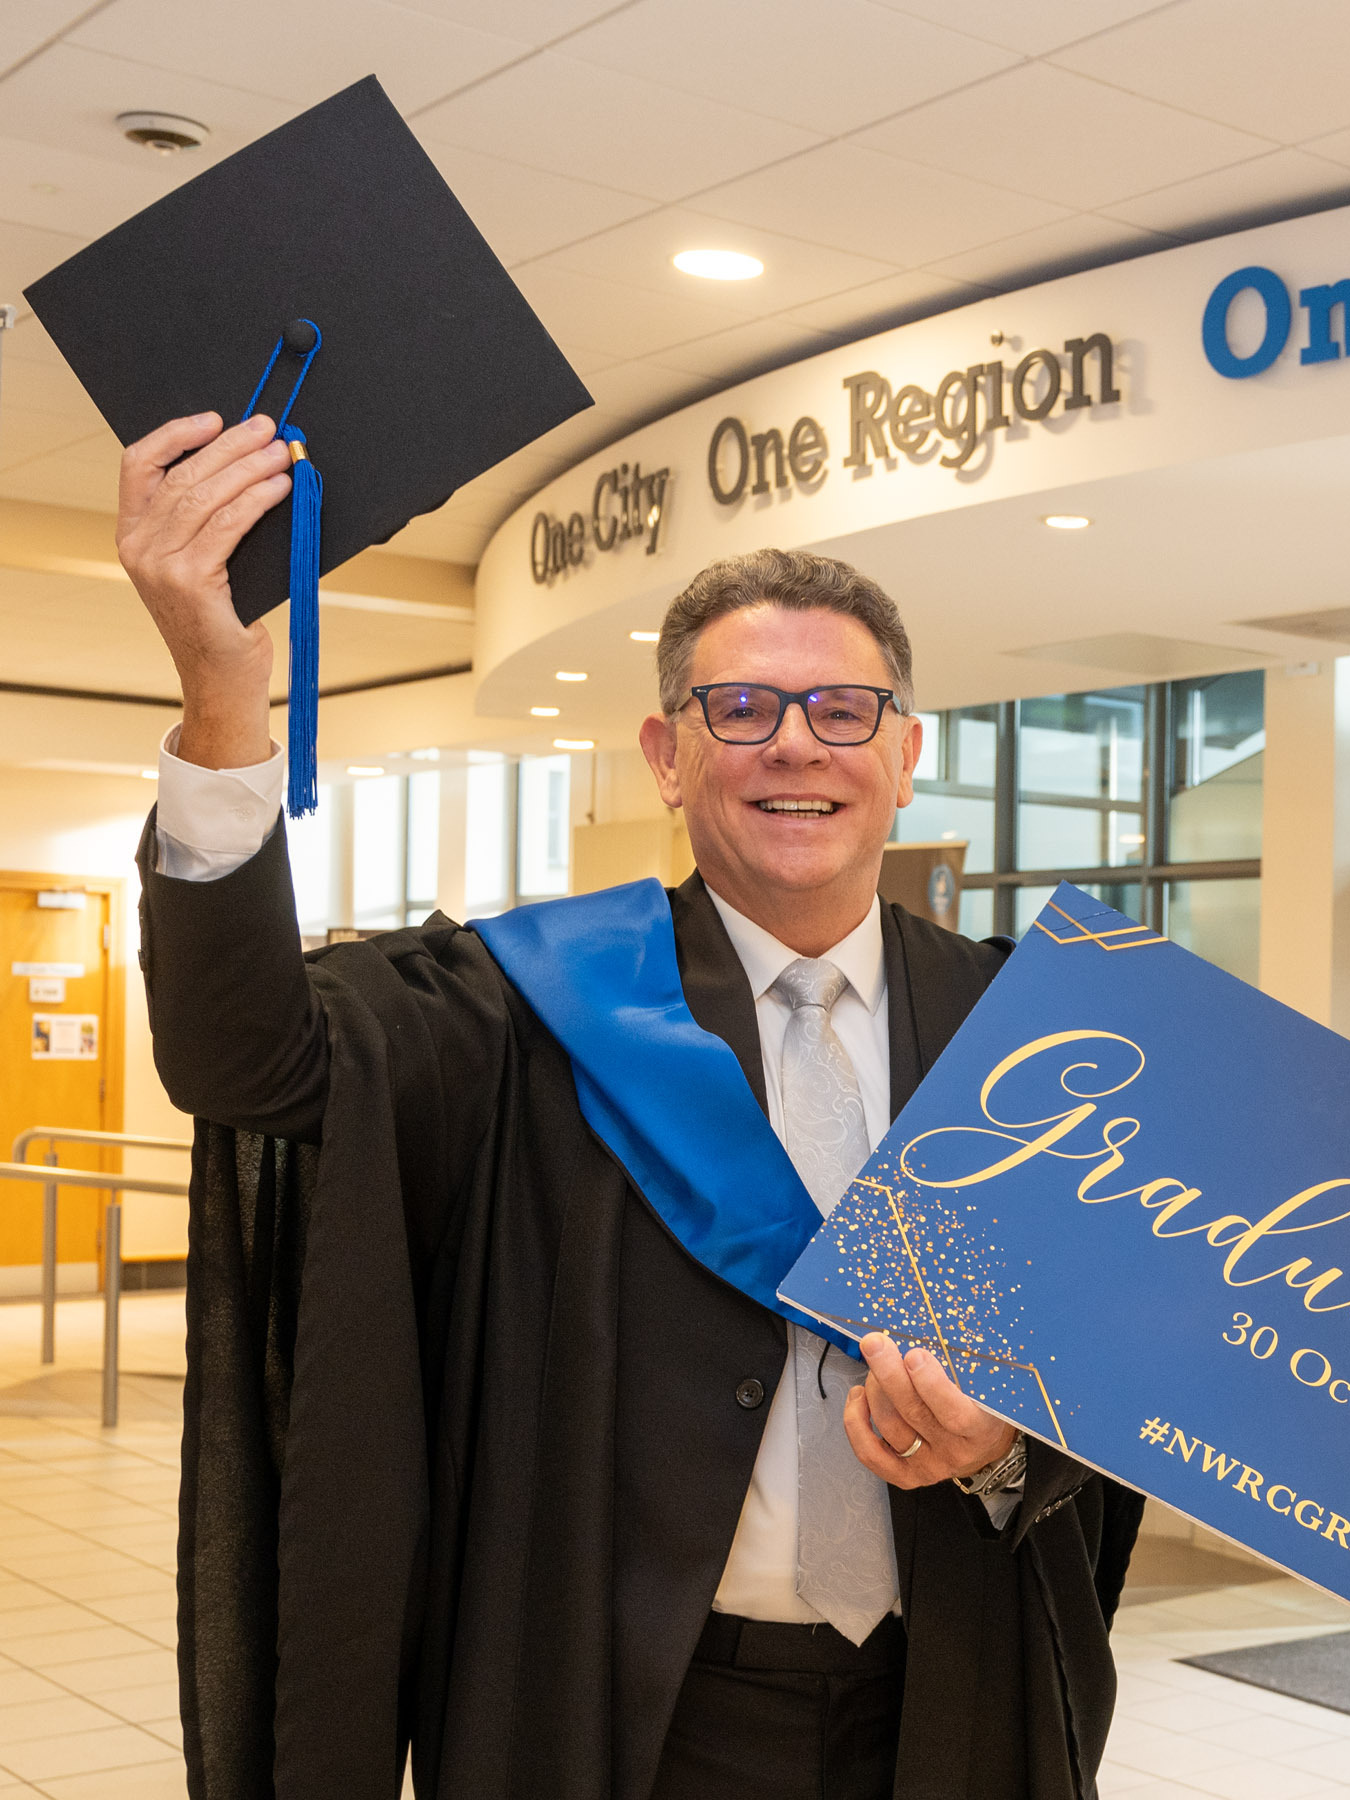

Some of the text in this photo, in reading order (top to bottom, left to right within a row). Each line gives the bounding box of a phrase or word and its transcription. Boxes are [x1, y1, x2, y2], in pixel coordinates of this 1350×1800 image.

[532, 512, 585, 584] One
[593, 462, 670, 556] City
[708, 416, 829, 506] One
[843, 330, 1121, 469] Region
[1222, 1312, 1279, 1360] 30
